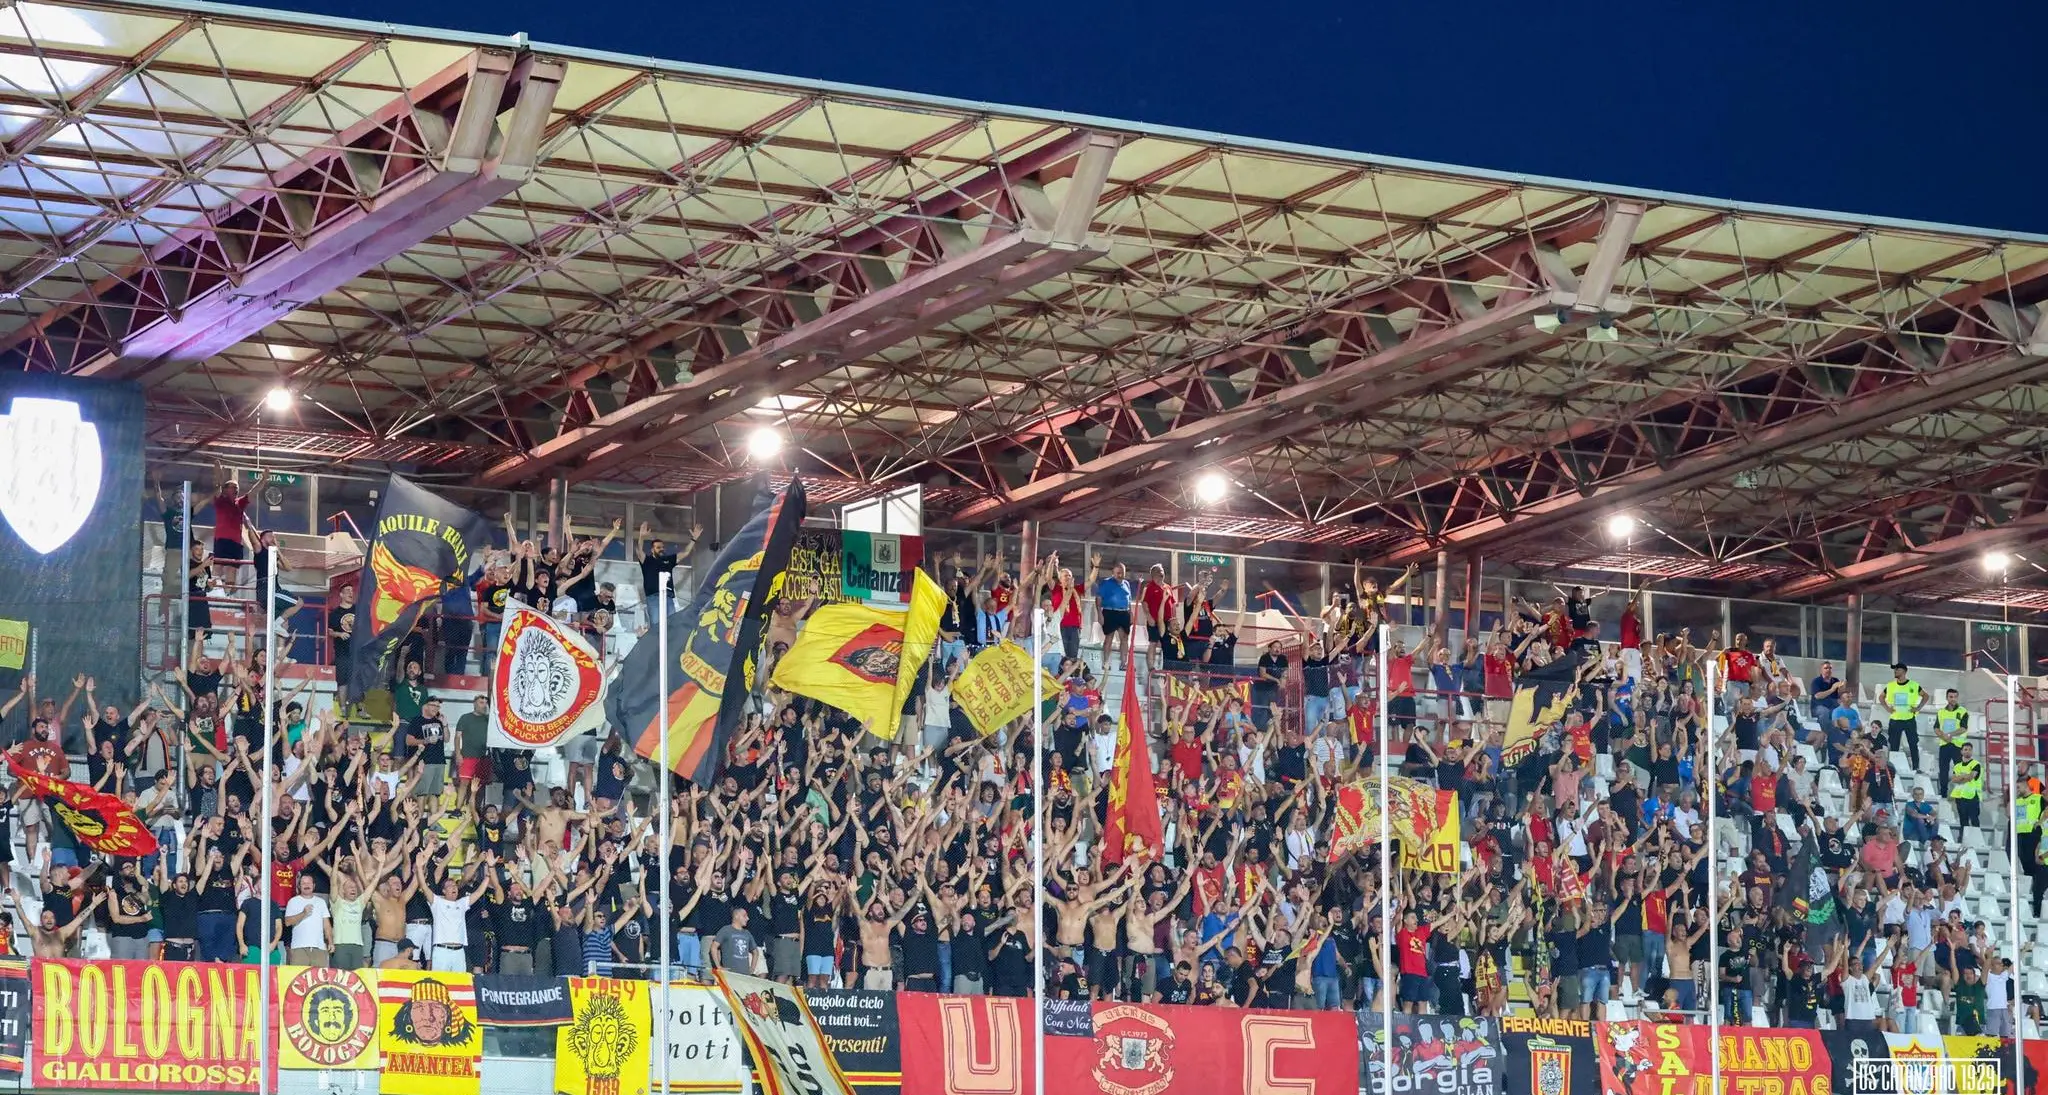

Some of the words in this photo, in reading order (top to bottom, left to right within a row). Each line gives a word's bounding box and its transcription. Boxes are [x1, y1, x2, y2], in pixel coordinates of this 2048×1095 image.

[378, 514, 440, 537] AQUILE
[1190, 554, 1214, 563] USCITA
[847, 551, 915, 593] Catanzar
[515, 728, 538, 741] FUCK
[522, 721, 545, 732] YOUR
[481, 986, 564, 1007] PONTEGRANDE
[846, 995, 858, 1008] di
[859, 996, 884, 1010] cielo
[43, 963, 261, 1062] BOLOGNA
[1042, 999, 1090, 1015] Diffidati
[1103, 1005, 1156, 1025] ULTRAS
[818, 1015, 827, 1026] a
[828, 1013, 853, 1027] tutti
[1044, 1013, 1065, 1029] Con
[1066, 1015, 1091, 1031] Noi
[1502, 1016, 1591, 1037] FIERAMENTE
[287, 1023, 375, 1064] BOLOGNA
[823, 1034, 888, 1054] Presenti!
[938, 998, 1024, 1095] U
[1708, 1035, 1813, 1073] SIANO
[42, 1060, 261, 1086] GIALLOROSSA
[387, 1052, 474, 1078] AMANTEA
[585, 1077, 620, 1095] 1989
[1457, 1084, 1494, 1095] CLAN
